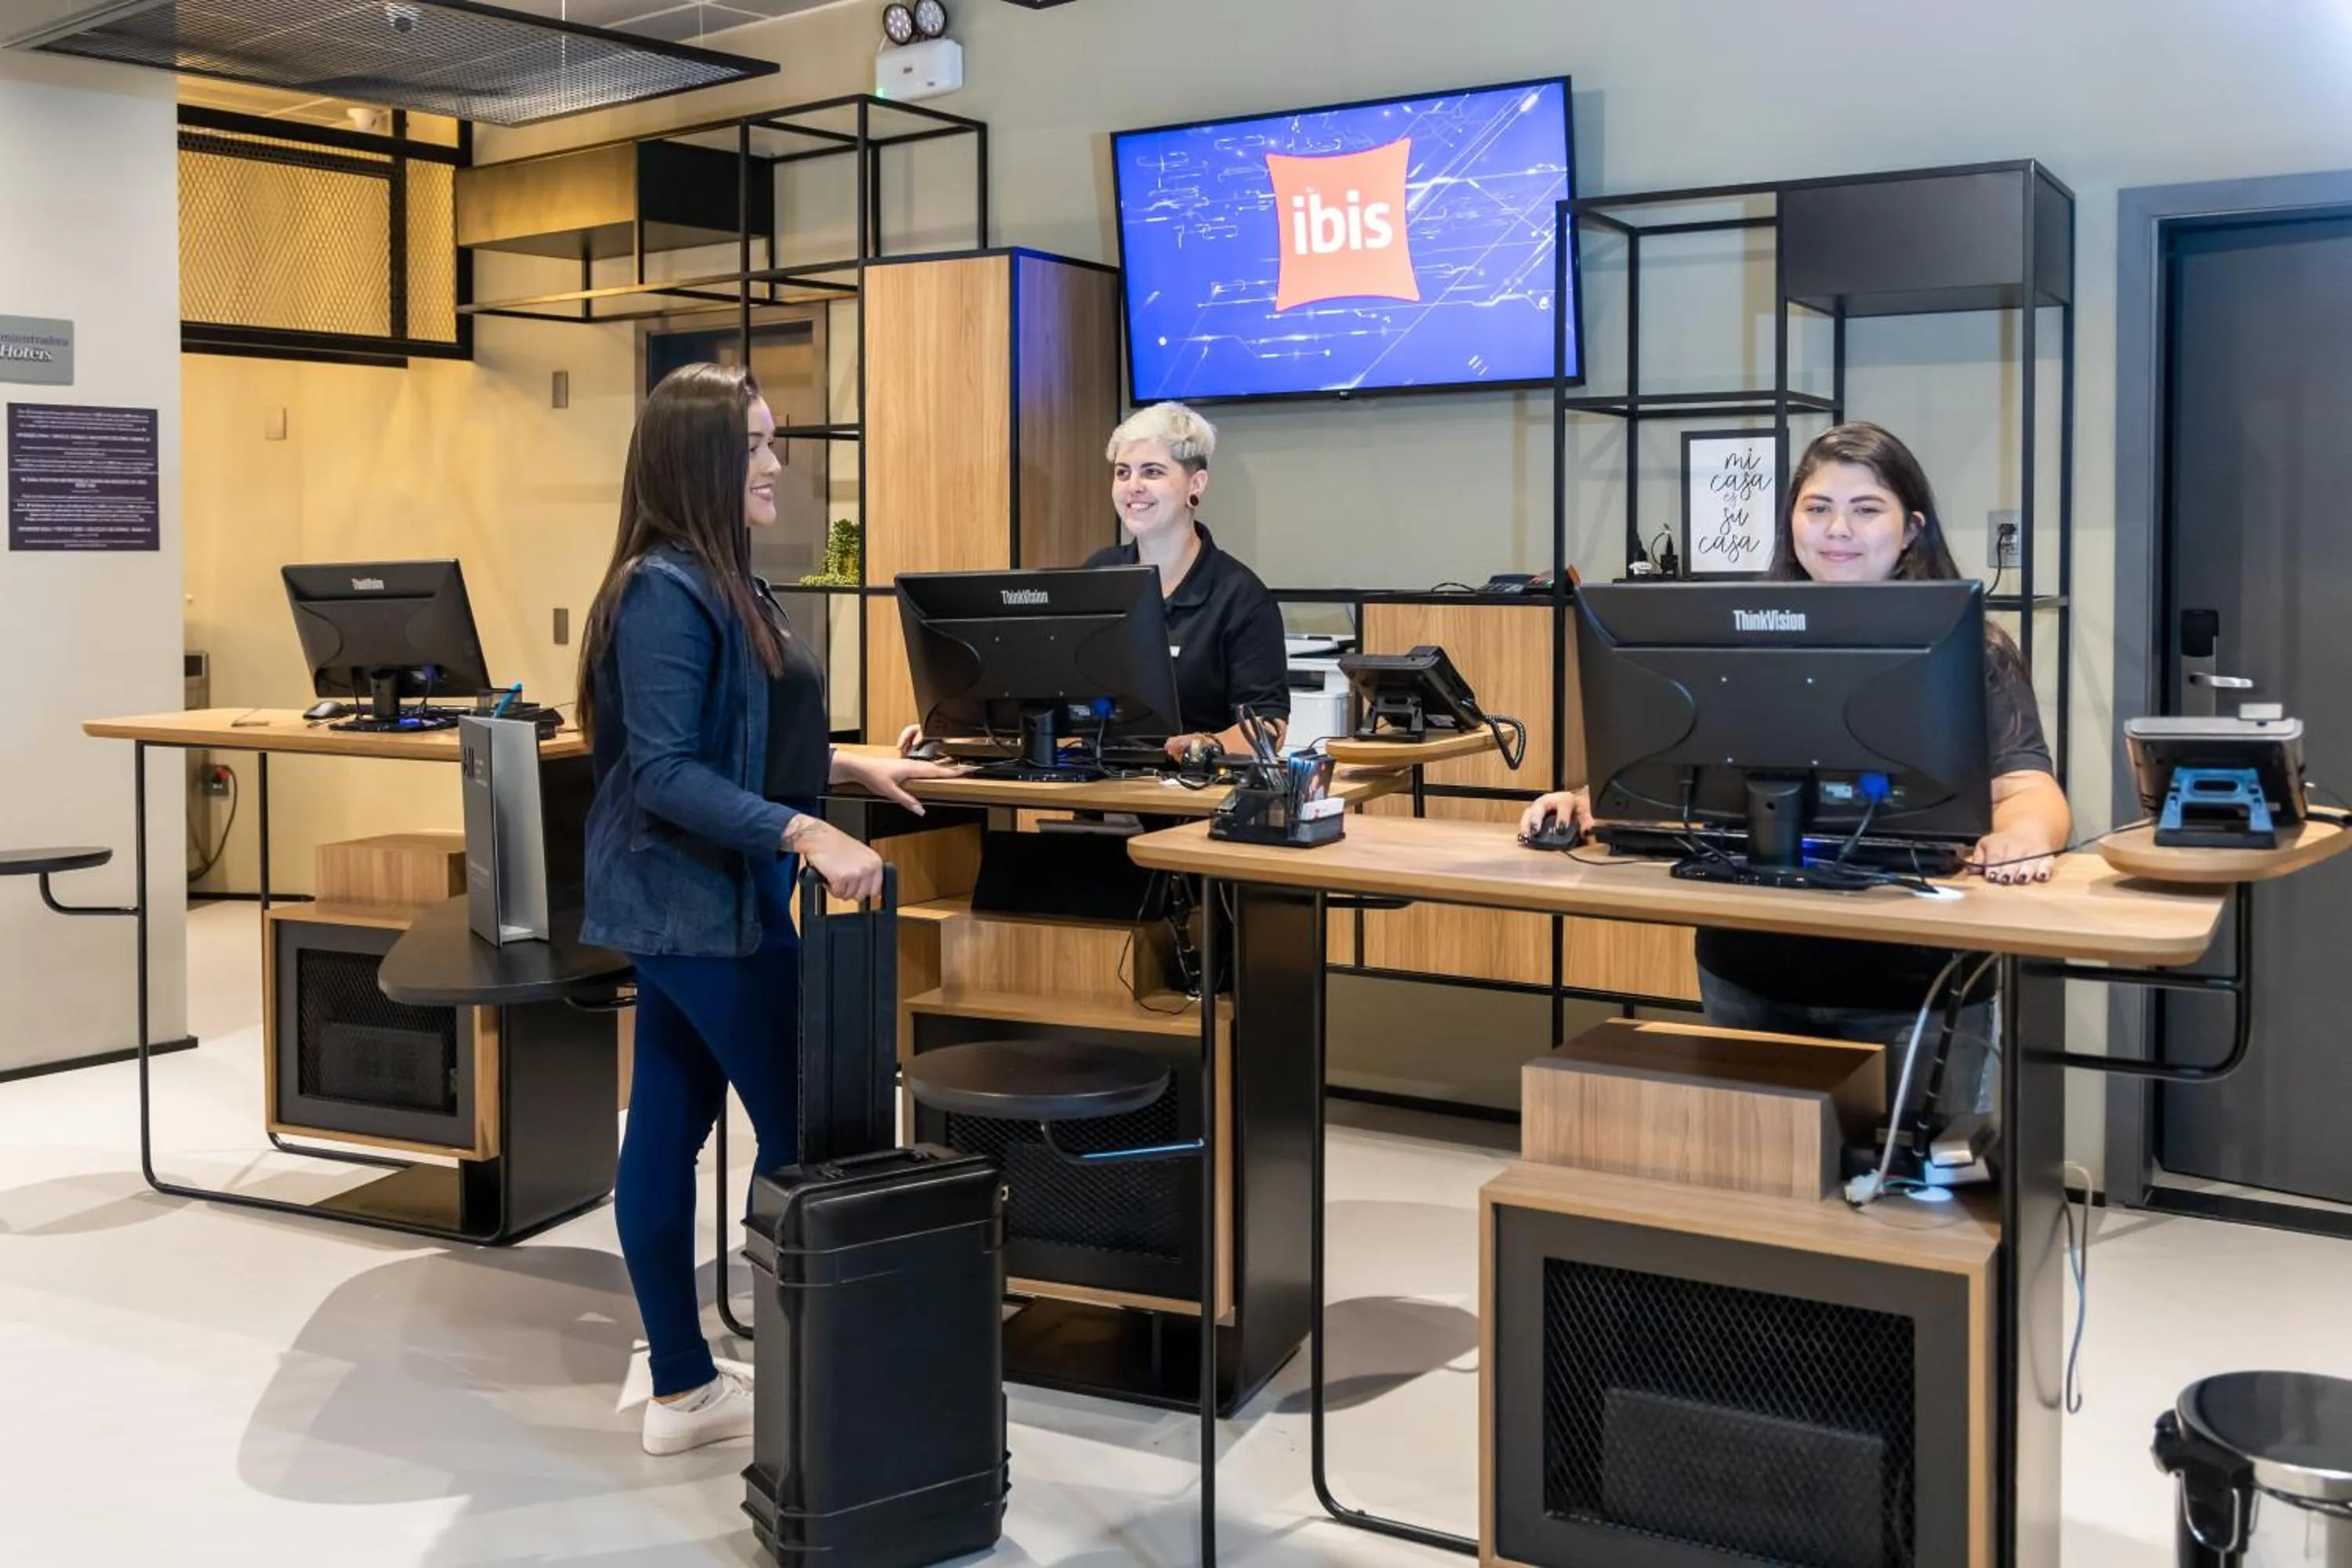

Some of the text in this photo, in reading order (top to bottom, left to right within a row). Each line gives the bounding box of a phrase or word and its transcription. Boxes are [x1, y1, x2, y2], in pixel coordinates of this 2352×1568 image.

[1291, 190, 1393, 255] ibis
[1725, 447, 1761, 470] mi
[1710, 471, 1773, 501] casa
[1719, 507, 1749, 535] su
[1698, 534, 1760, 563] casa
[1732, 609, 1806, 631] ThinkVision
